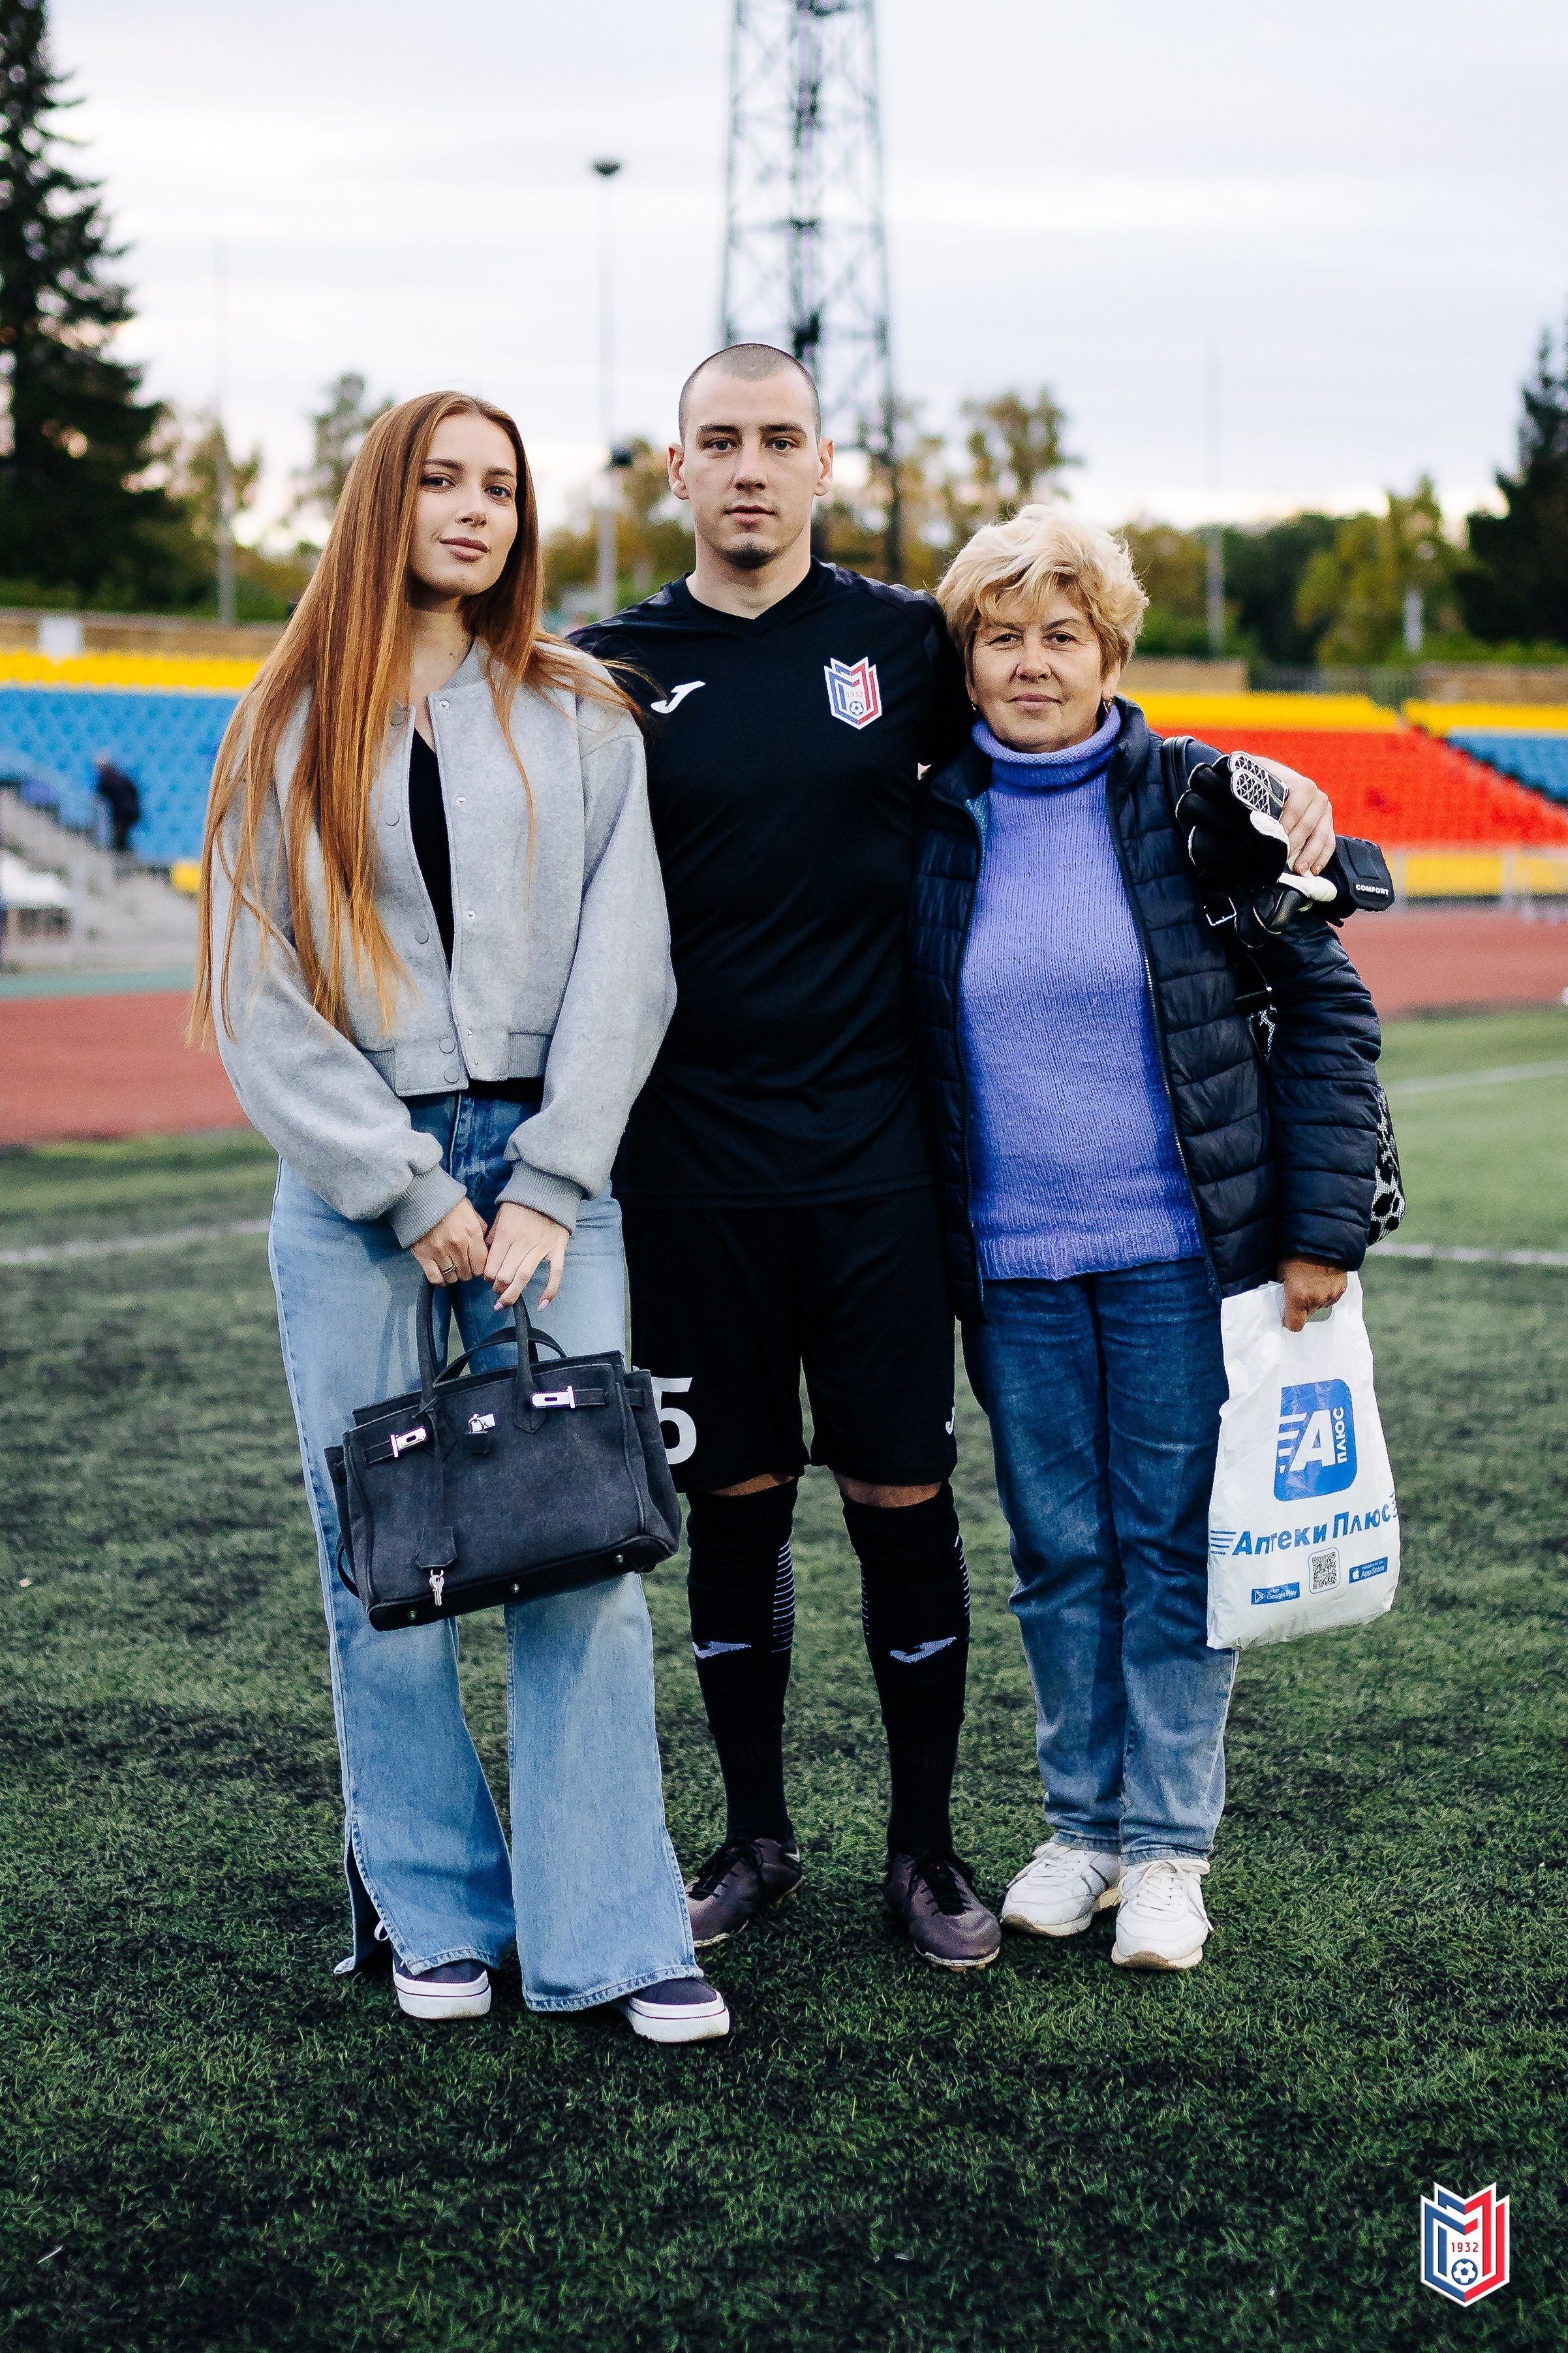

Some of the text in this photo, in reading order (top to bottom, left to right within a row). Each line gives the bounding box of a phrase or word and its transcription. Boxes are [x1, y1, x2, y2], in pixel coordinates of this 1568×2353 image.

[1356, 884, 1389, 895] COMFORT
[633, 1365, 696, 1464] 5
[1333, 1407, 1347, 1463] ПЛЮС
[1232, 1504, 1391, 1555] Аптеки Плюс
